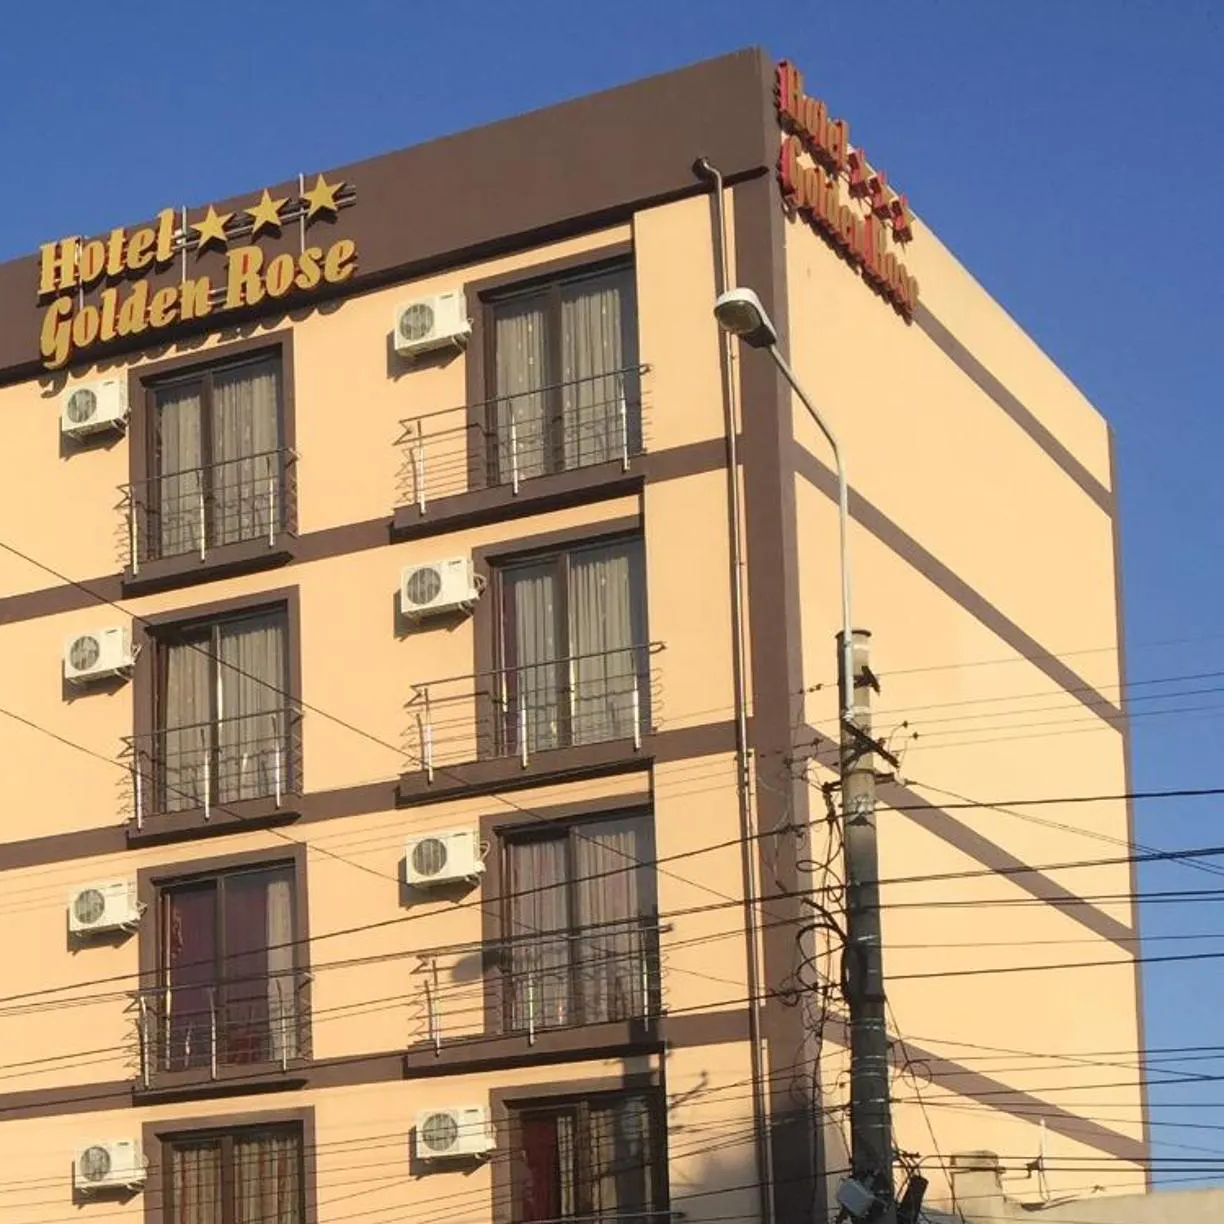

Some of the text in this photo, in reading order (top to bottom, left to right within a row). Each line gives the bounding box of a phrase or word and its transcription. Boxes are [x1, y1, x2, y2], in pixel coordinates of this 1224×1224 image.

[38, 207, 176, 295] Hotel
[40, 239, 356, 370] Golden Rose
